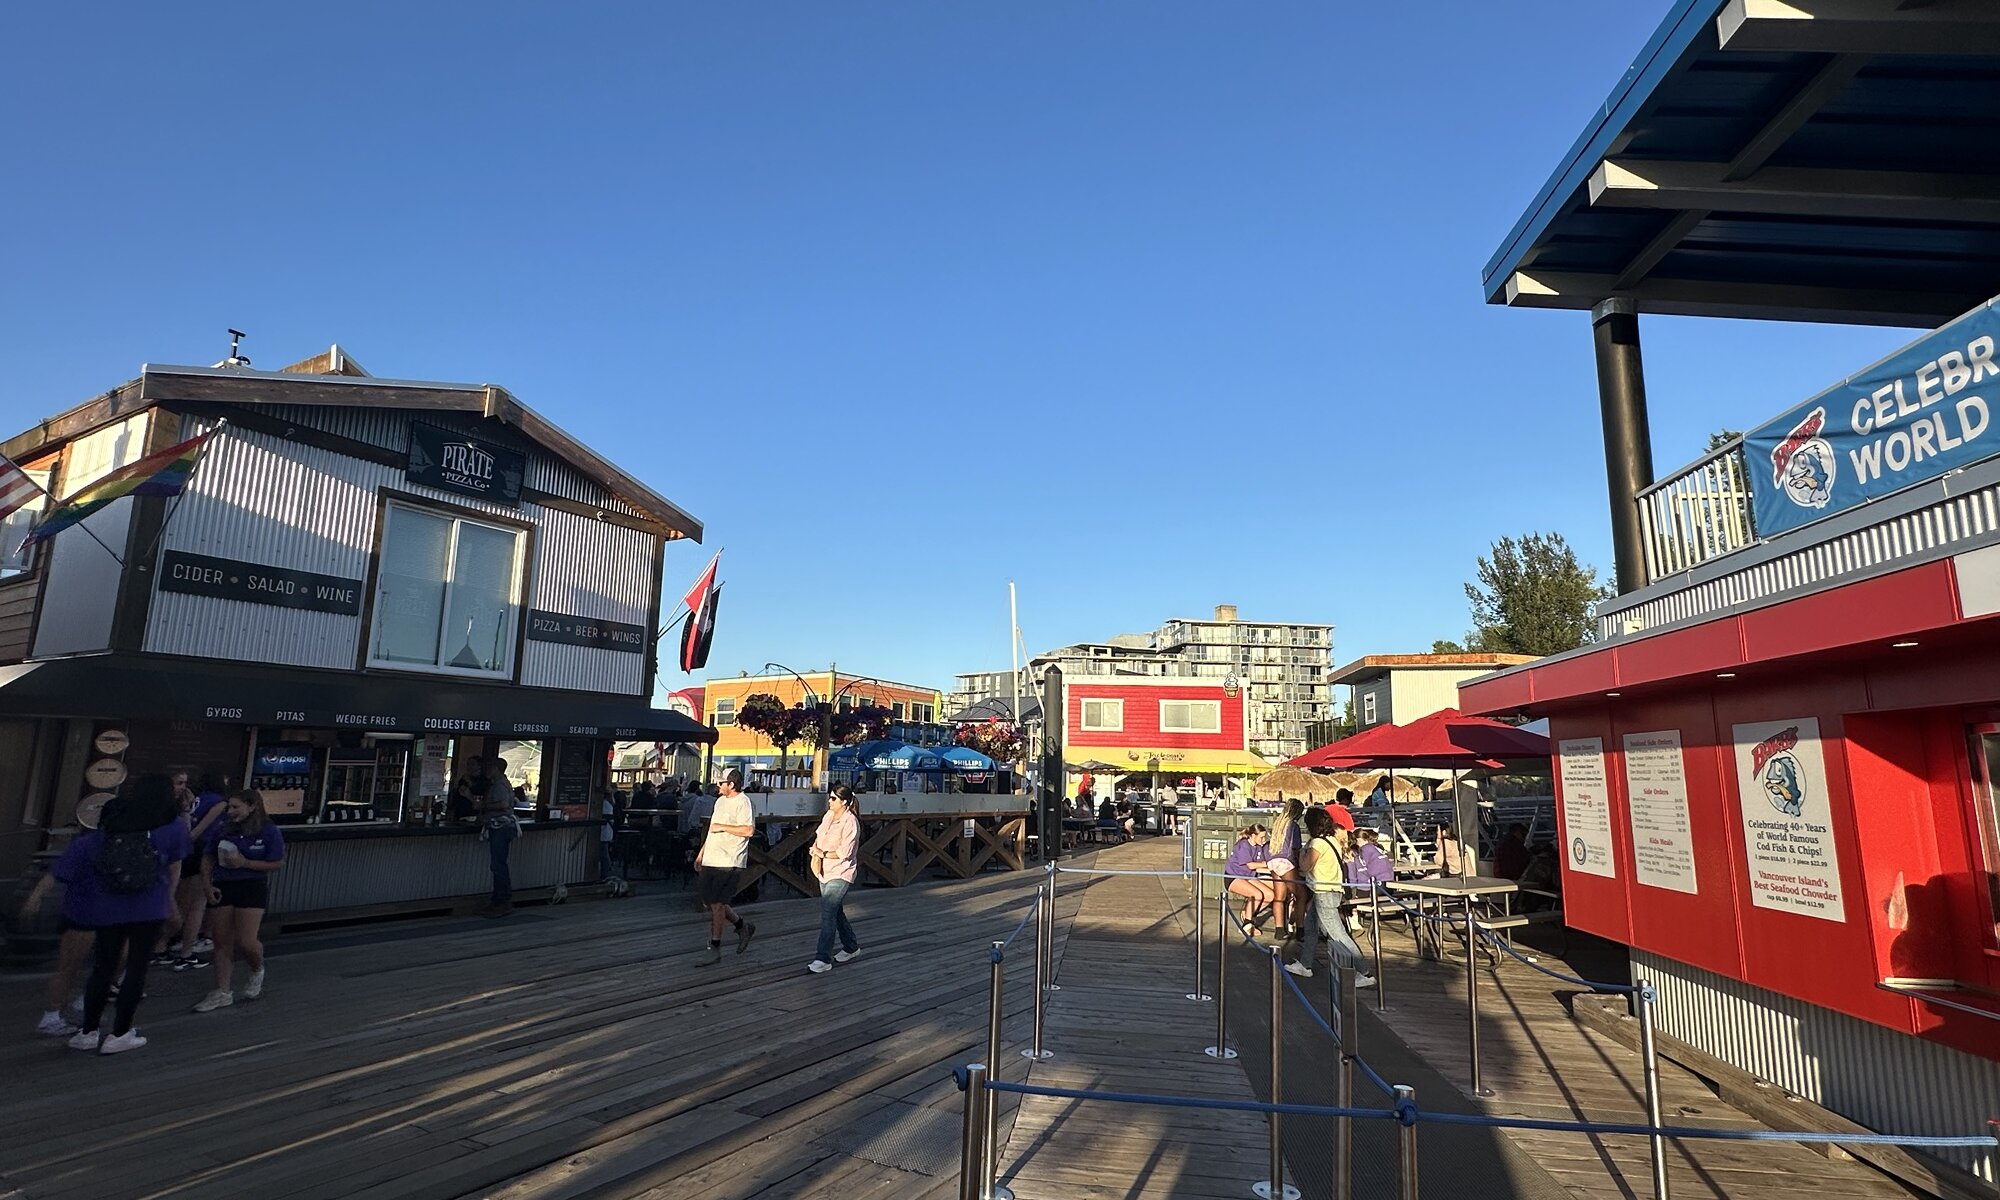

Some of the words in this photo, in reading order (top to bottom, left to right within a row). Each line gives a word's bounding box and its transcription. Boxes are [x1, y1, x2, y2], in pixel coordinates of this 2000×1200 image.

[1851, 335, 2000, 436] CELEBR
[1848, 395, 1990, 485] WORLD
[441, 445, 494, 480] PIRATE
[446, 472, 472, 486] PIZZA
[172, 563, 224, 585] CIDER
[247, 575, 295, 595] SALAD
[316, 584, 354, 604] WINE
[533, 618, 561, 633] PIZZA
[575, 624, 599, 638] BEER
[611, 630, 641, 645] WINGS
[206, 706, 243, 719] GYROS
[276, 711, 305, 722] PITAS
[335, 714, 368, 725] WEDGE
[370, 715, 397, 726] FRIES
[424, 718, 466, 731] COLDEST
[467, 719, 491, 731] BEER
[513, 723, 550, 733] ESPRESSO
[569, 726, 598, 735] SEAFOOD
[615, 728, 637, 736] SLICES
[279, 755, 306, 765] pepsi
[873, 757, 910, 766] PHILLIPS
[953, 759, 983, 767] PHILLIPS
[1748, 819, 1790, 833] Celebrating
[1789, 821, 1804, 832] 40+
[1804, 823, 1827, 833] Years
[1756, 831, 1765, 840] of
[1765, 831, 1788, 842] World
[1789, 833, 1819, 845] Famous
[1756, 841, 1771, 852] Cod
[1772, 842, 1788, 853] Fish
[1788, 844, 1796, 854] &
[1797, 845, 1823, 858] Chips!
[1757, 869, 1796, 884] Vancouver
[1798, 874, 1829, 889] Island's
[1753, 880, 1769, 890] Best
[1769, 882, 1800, 896] Seafood
[1801, 887, 1838, 902] Chowder
